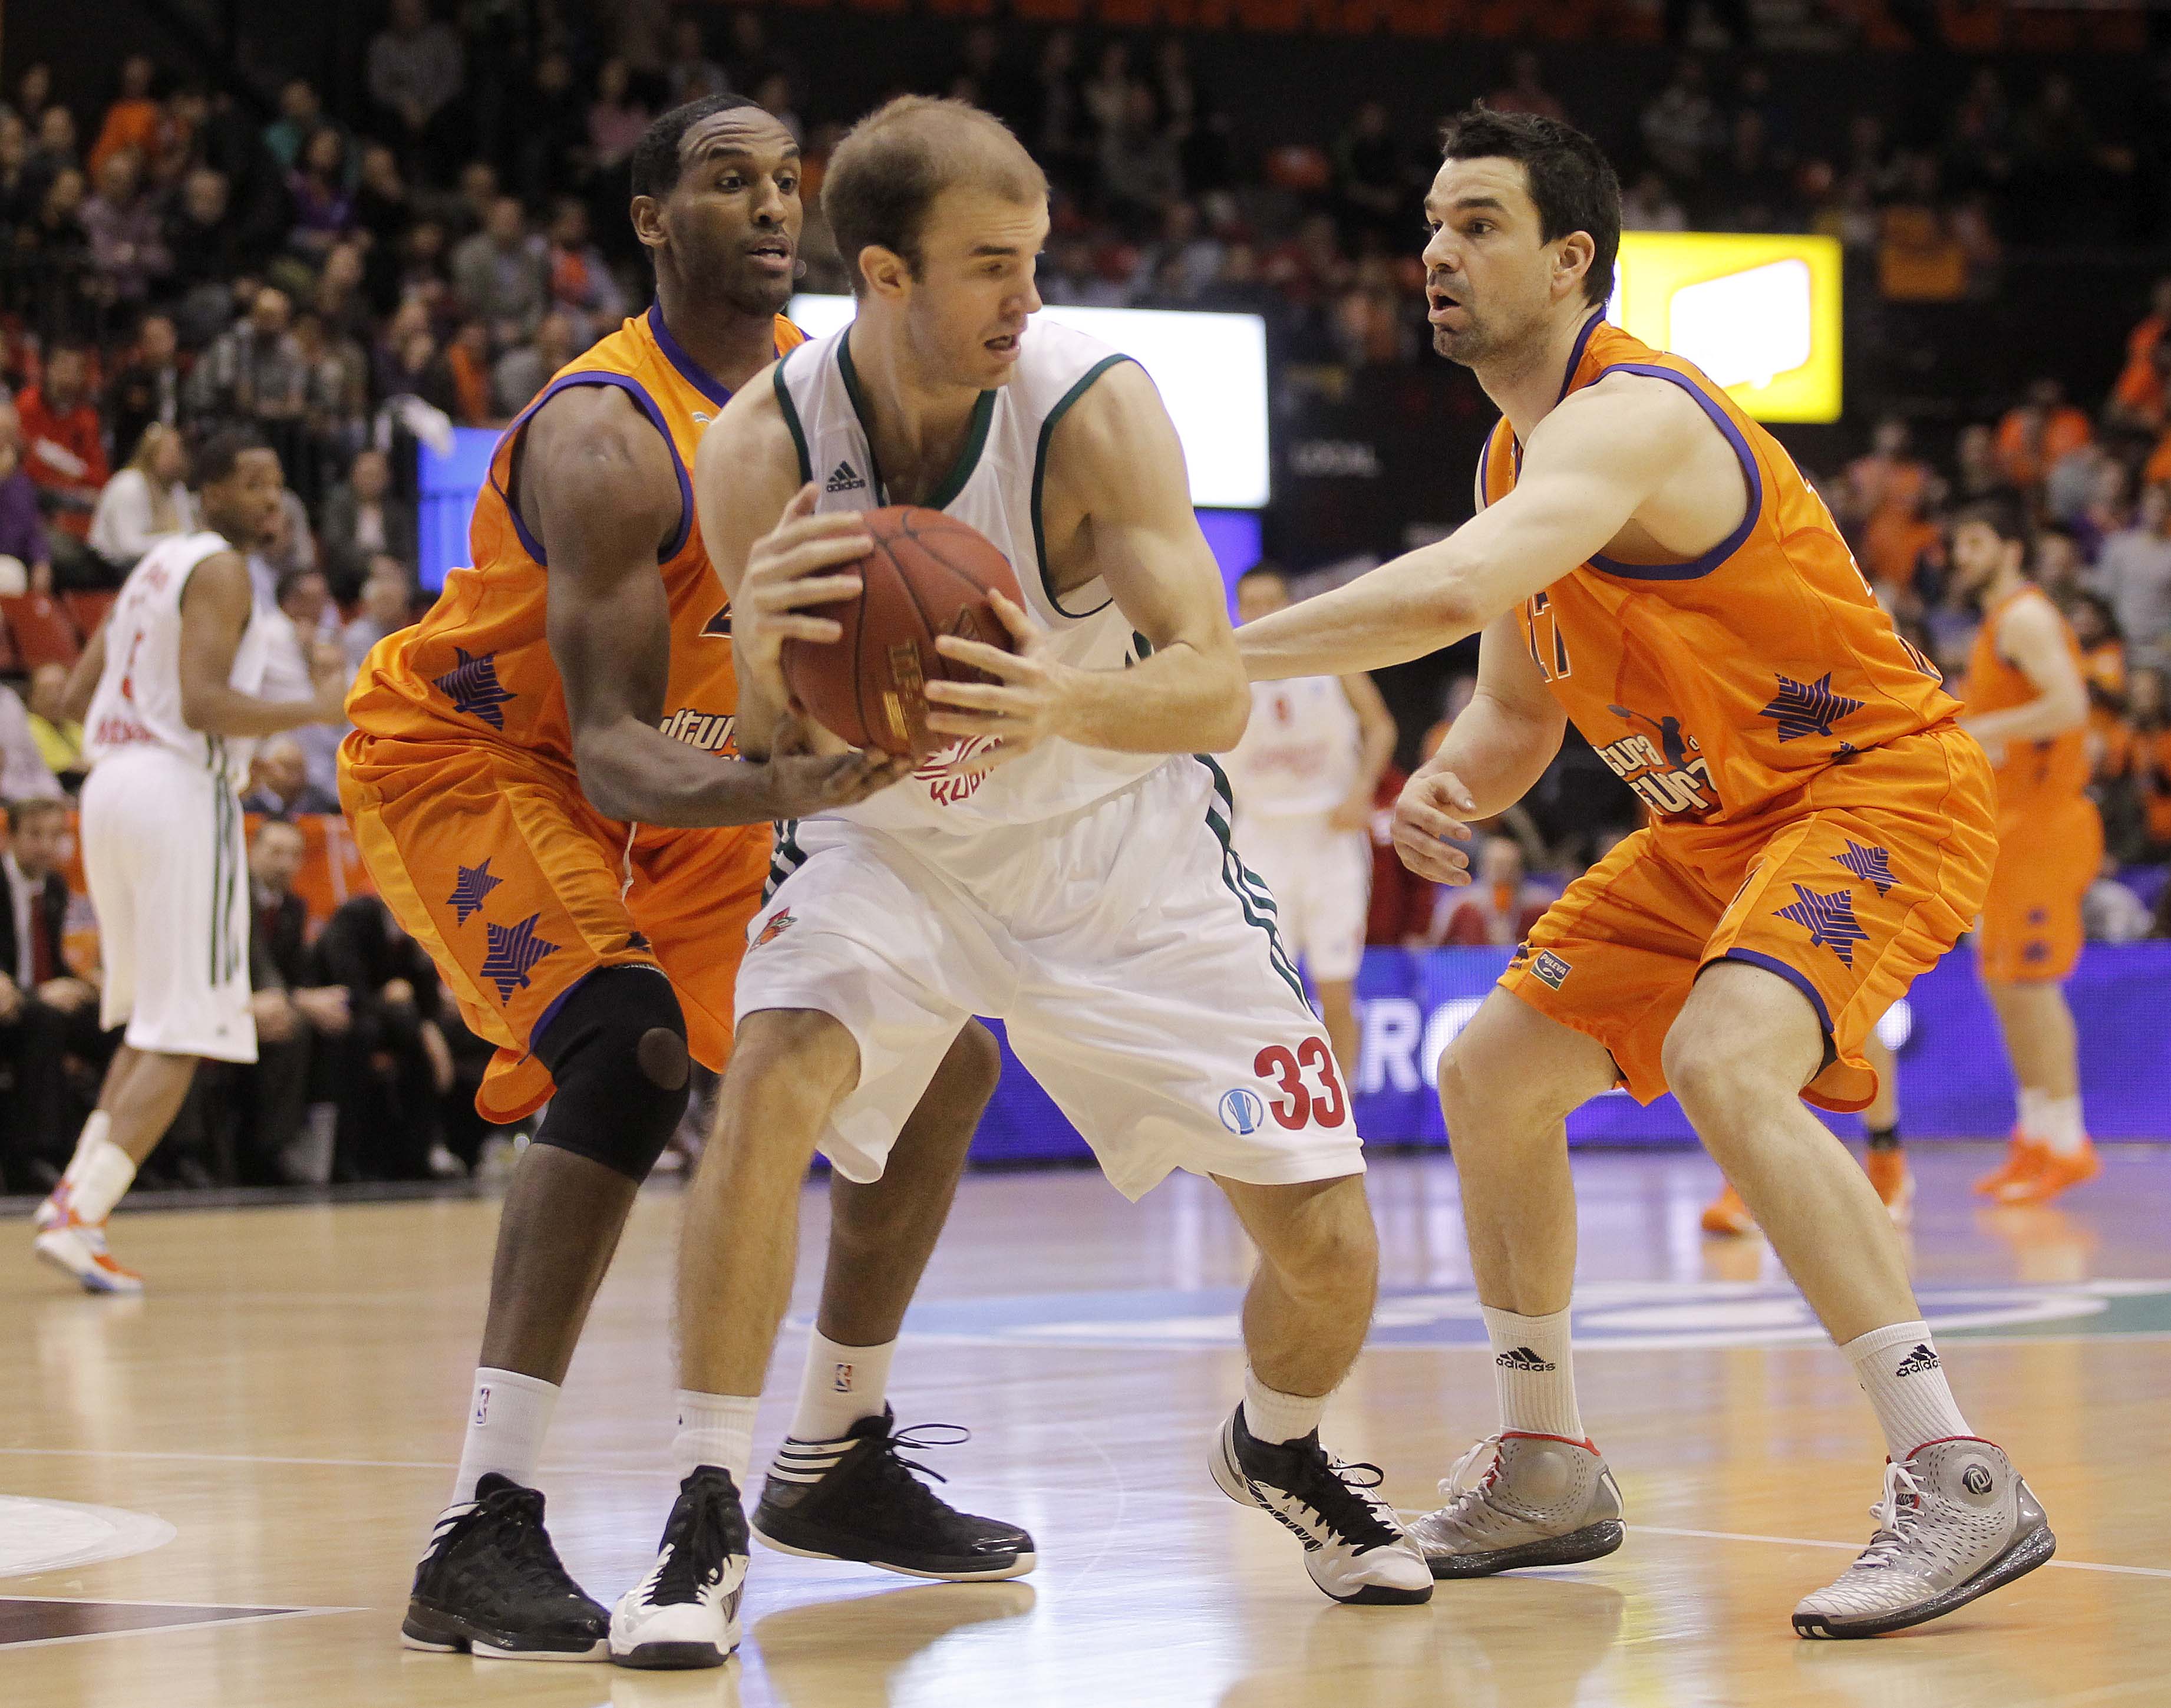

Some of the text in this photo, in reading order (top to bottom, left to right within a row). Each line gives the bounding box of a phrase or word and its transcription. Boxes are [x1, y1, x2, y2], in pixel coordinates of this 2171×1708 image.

[827, 479, 865, 493] adidas
[1540, 953, 1567, 975] PULEVA
[1254, 1036, 1345, 1130] 33
[1496, 1357, 1556, 1371] adidas
